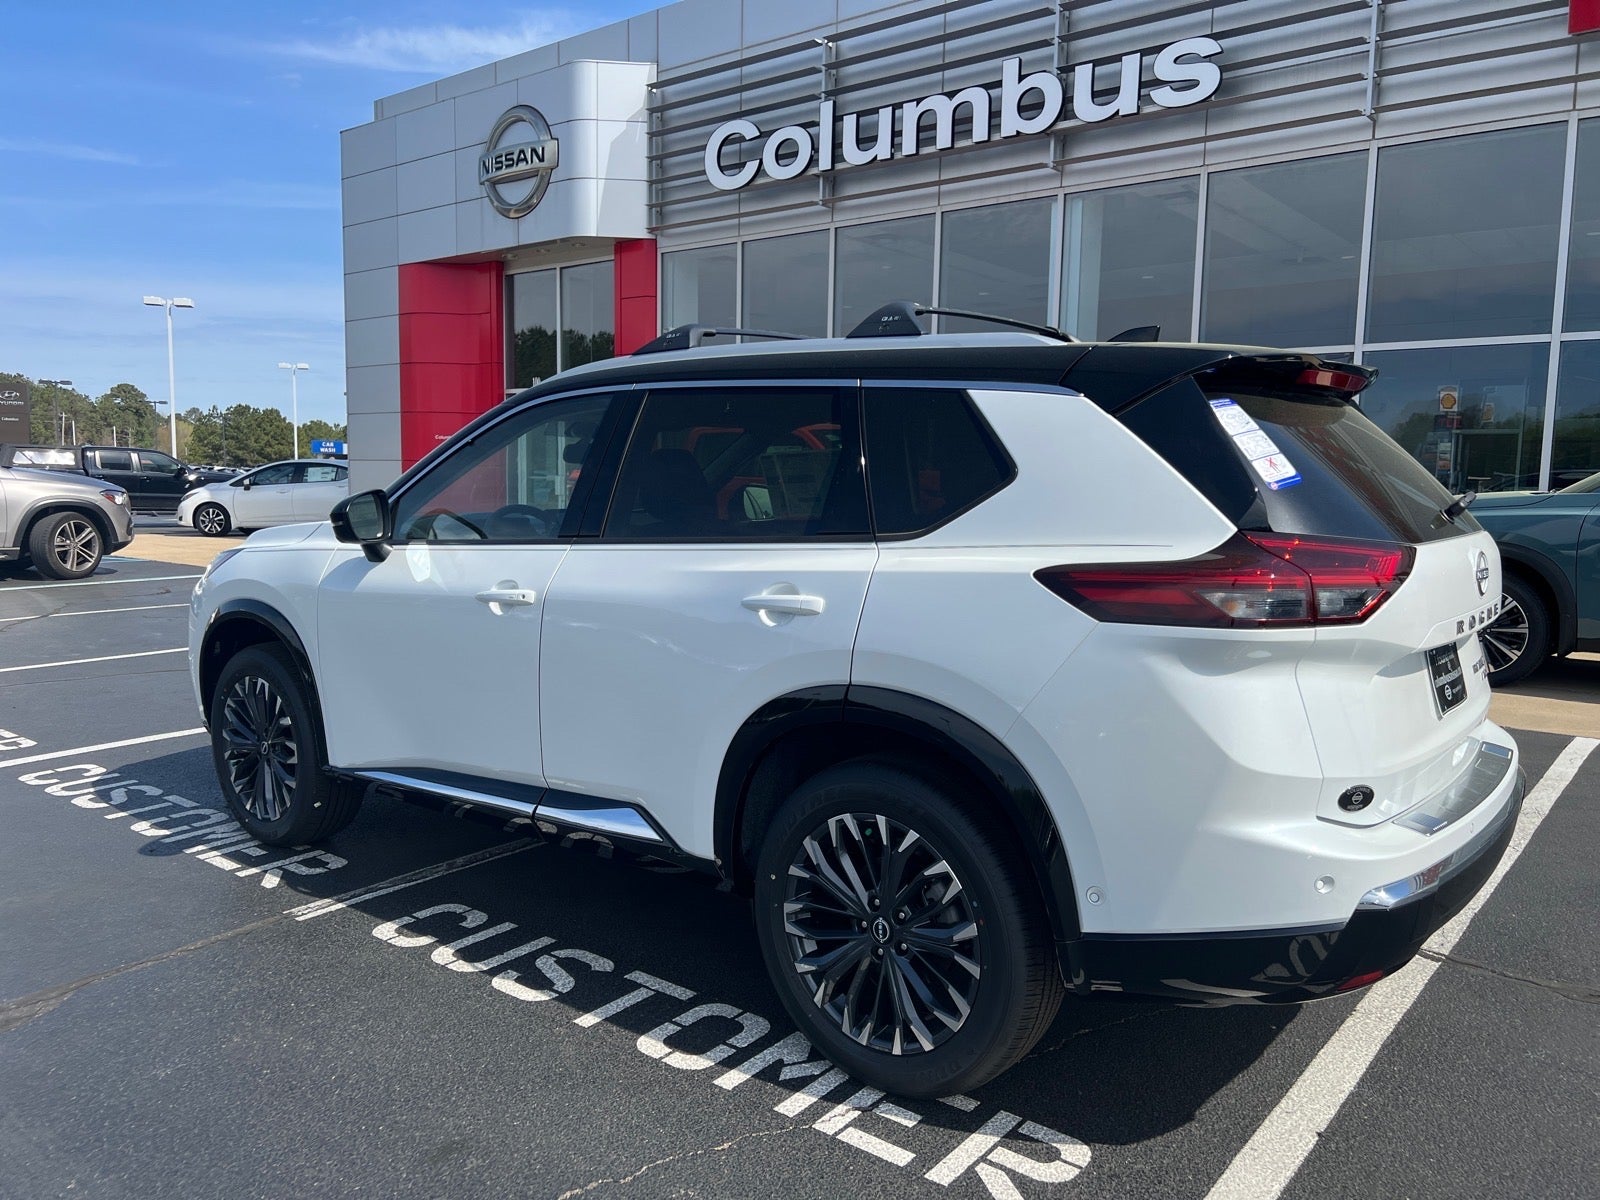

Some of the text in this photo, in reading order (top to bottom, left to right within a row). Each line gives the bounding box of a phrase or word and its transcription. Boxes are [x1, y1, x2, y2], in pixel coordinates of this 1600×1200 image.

[481, 145, 546, 178] NISSAN
[703, 36, 1224, 191] Columbus
[1456, 603, 1499, 636] ROGUE
[18, 763, 349, 889] CUSTOMER
[370, 902, 1093, 1200] CUSTOMER
